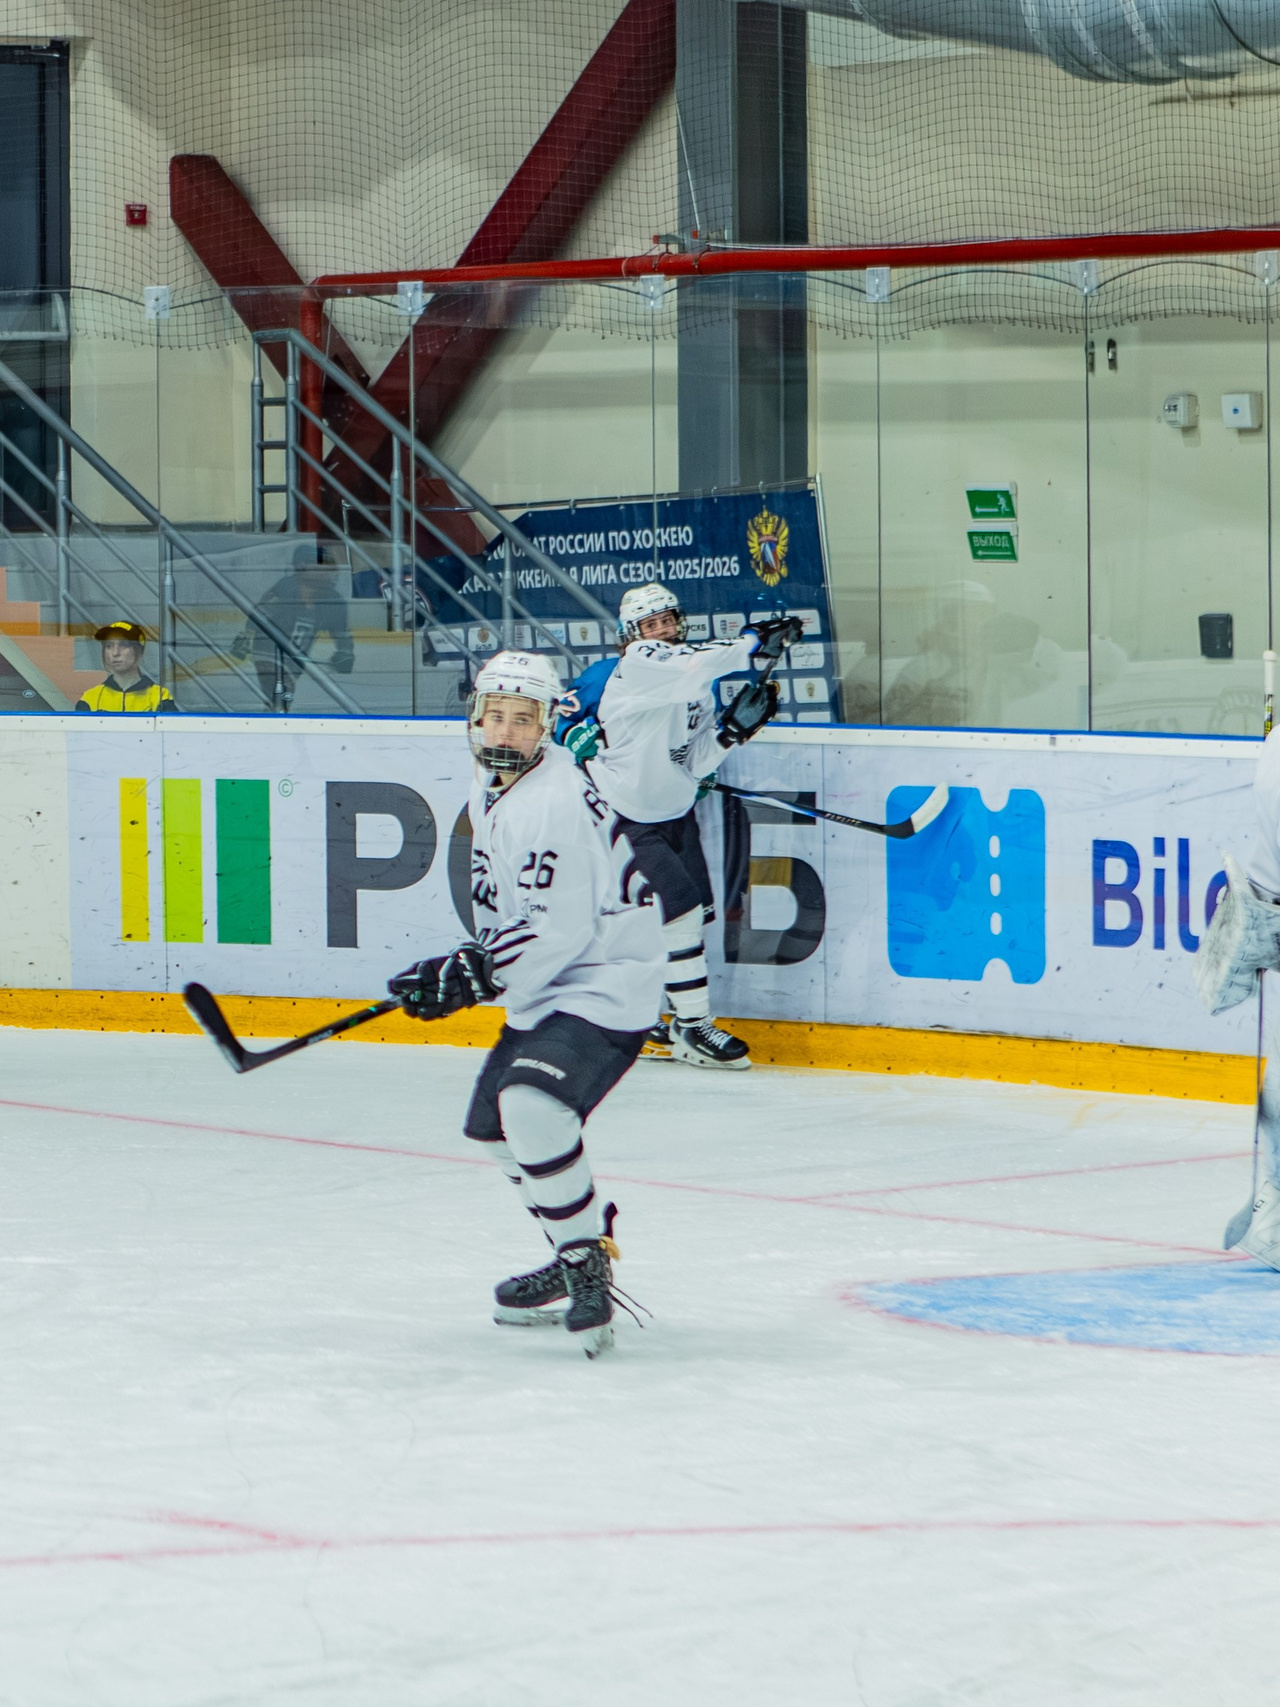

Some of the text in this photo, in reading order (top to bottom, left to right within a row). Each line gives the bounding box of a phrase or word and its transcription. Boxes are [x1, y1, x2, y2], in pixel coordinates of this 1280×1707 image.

[549, 532, 605, 555] РОССИИ
[608, 529, 630, 551] ПО
[632, 526, 693, 549] ХОККЕЮ
[972, 535, 1009, 548] ВЫХОД
[581, 563, 618, 586] ЛИГА
[620, 559, 665, 583] СЕЗОН
[668, 556, 739, 581] 2025/2026
[517, 850, 558, 890] 26
